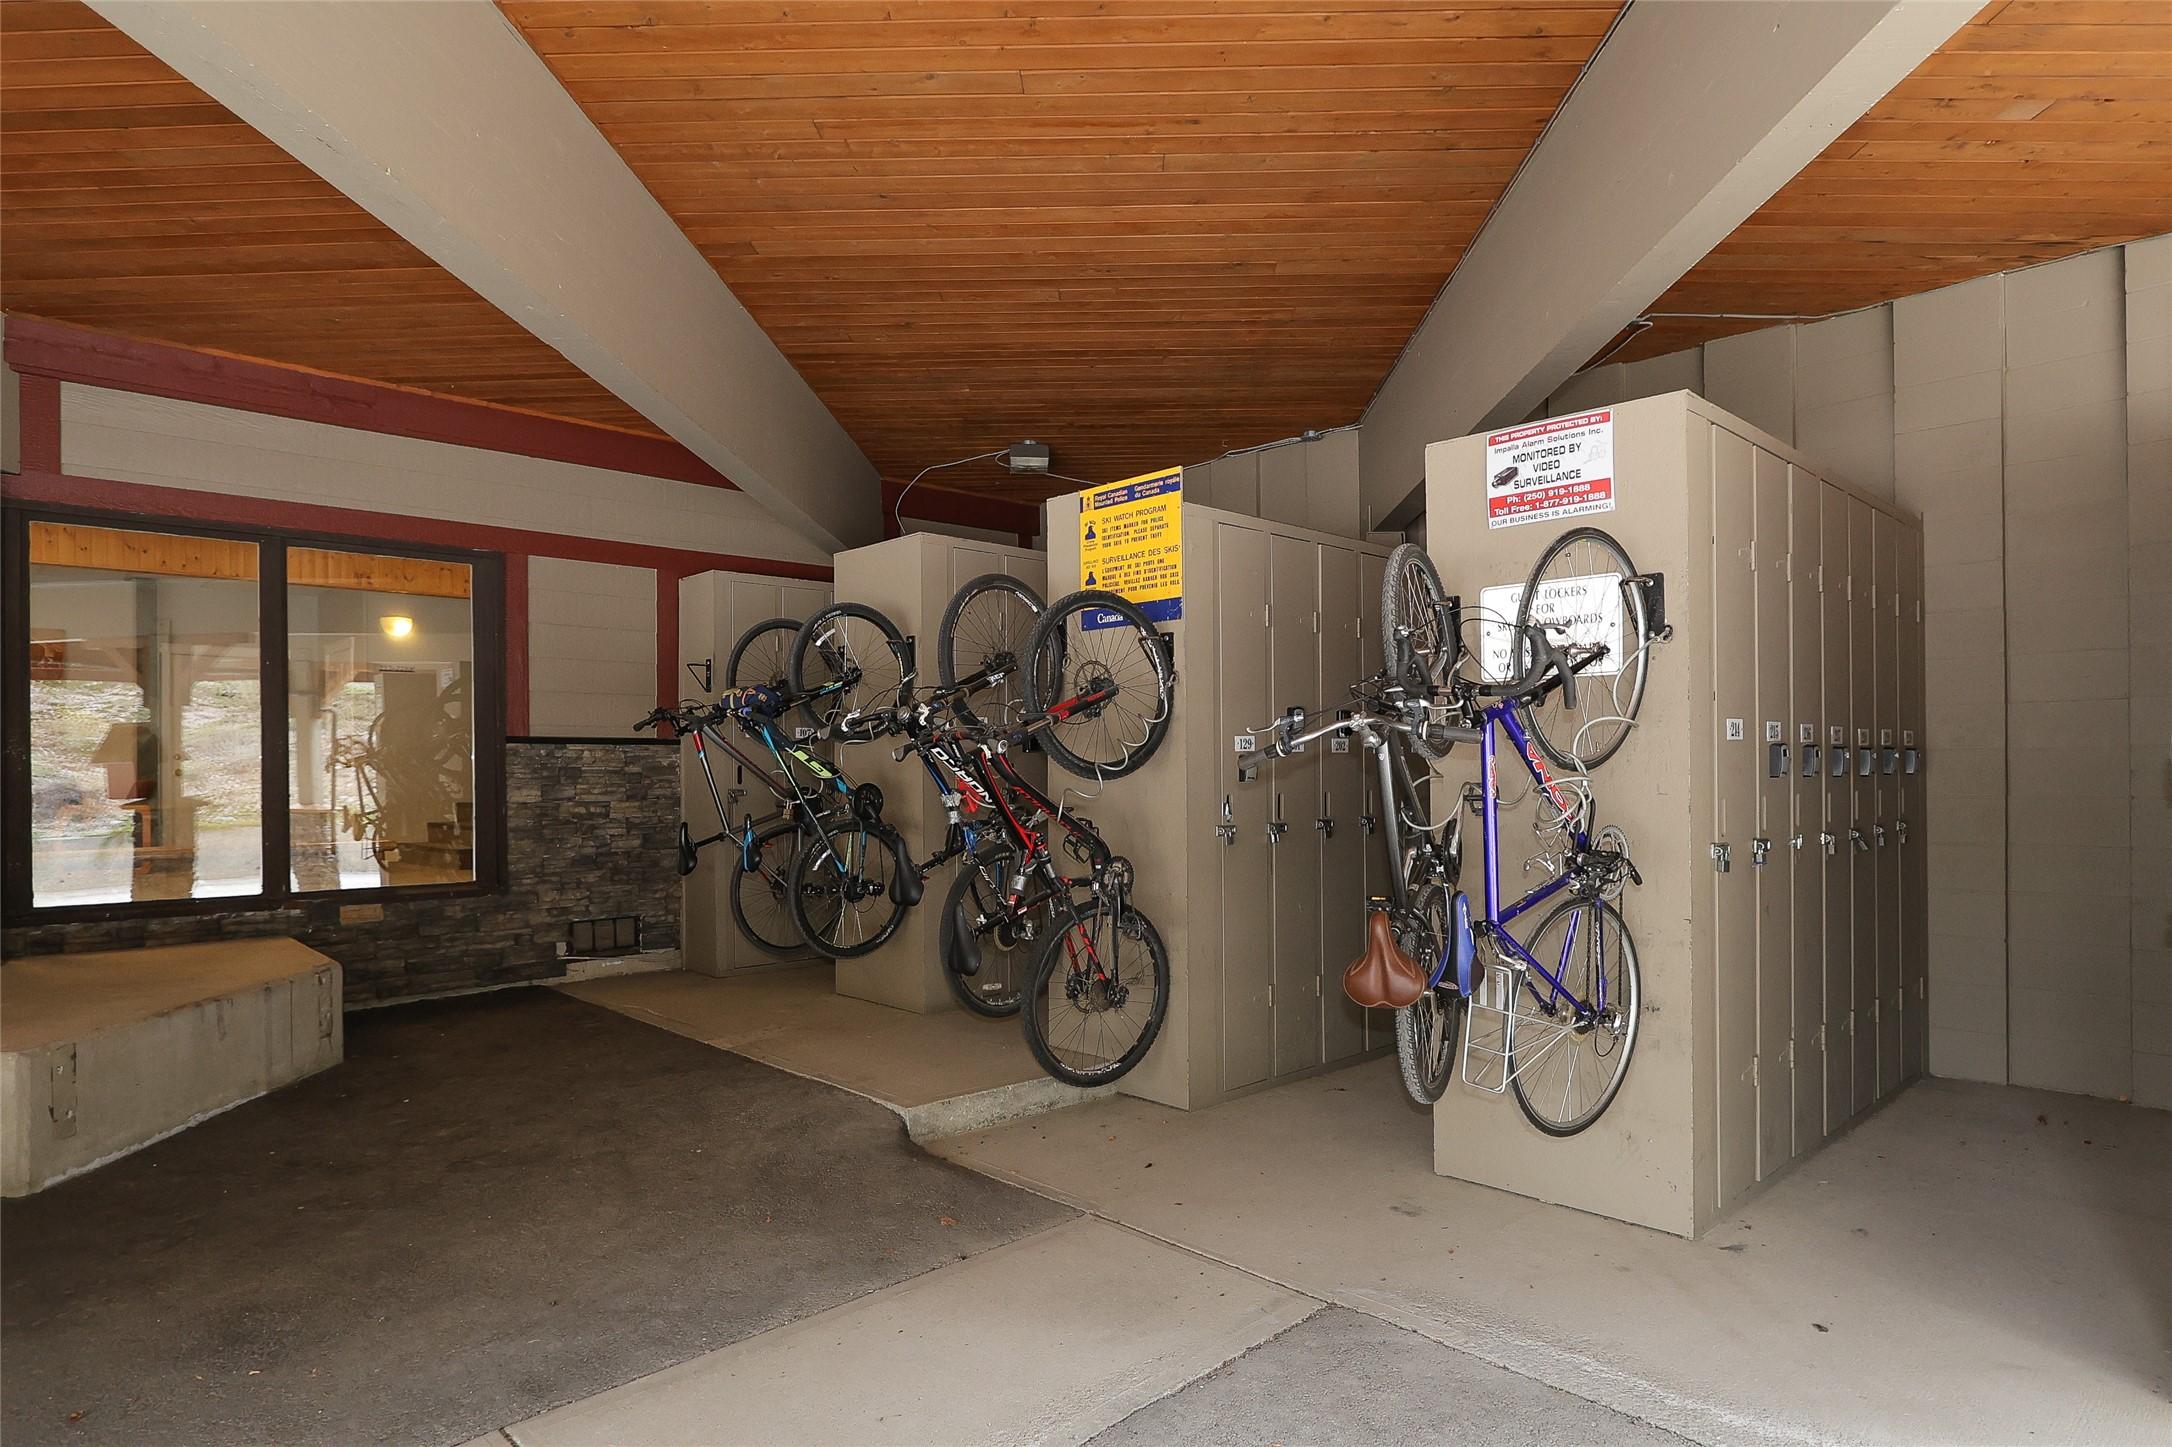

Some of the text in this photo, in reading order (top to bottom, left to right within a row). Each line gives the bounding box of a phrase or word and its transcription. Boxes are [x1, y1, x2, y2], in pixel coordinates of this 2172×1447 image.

[1511, 426, 1545, 439] PROPERTY
[1547, 419, 1588, 431] PROTECTED
[1522, 439, 1544, 448] Alarm
[1547, 432, 1585, 443] Solutions
[1513, 443, 1581, 464] MONITORED BY
[1533, 460, 1560, 472] VIDEO
[1514, 469, 1581, 489] SURVEILLANCE
[1507, 484, 1590, 504] Ph: (250) 919-1888
[1494, 491, 1606, 516] Toll Free: 1-877-919-1888
[1114, 512, 1133, 521] WATCH
[1136, 504, 1166, 517] PROGRAM
[1510, 512, 1549, 523] BUSINESS
[1562, 502, 1611, 514] ALARMING!
[1102, 551, 1145, 565] SURVEILLANCE
[1148, 548, 1161, 556] DES
[1545, 585, 1587, 600] LOCKERS
[1536, 603, 1555, 614] FOR
[1097, 613, 1123, 623] Canada
[1493, 648, 1507, 660] NO
[1239, 738, 1252, 750] 129
[1335, 740, 1346, 751] 202
[931, 748, 992, 802] NORCO
